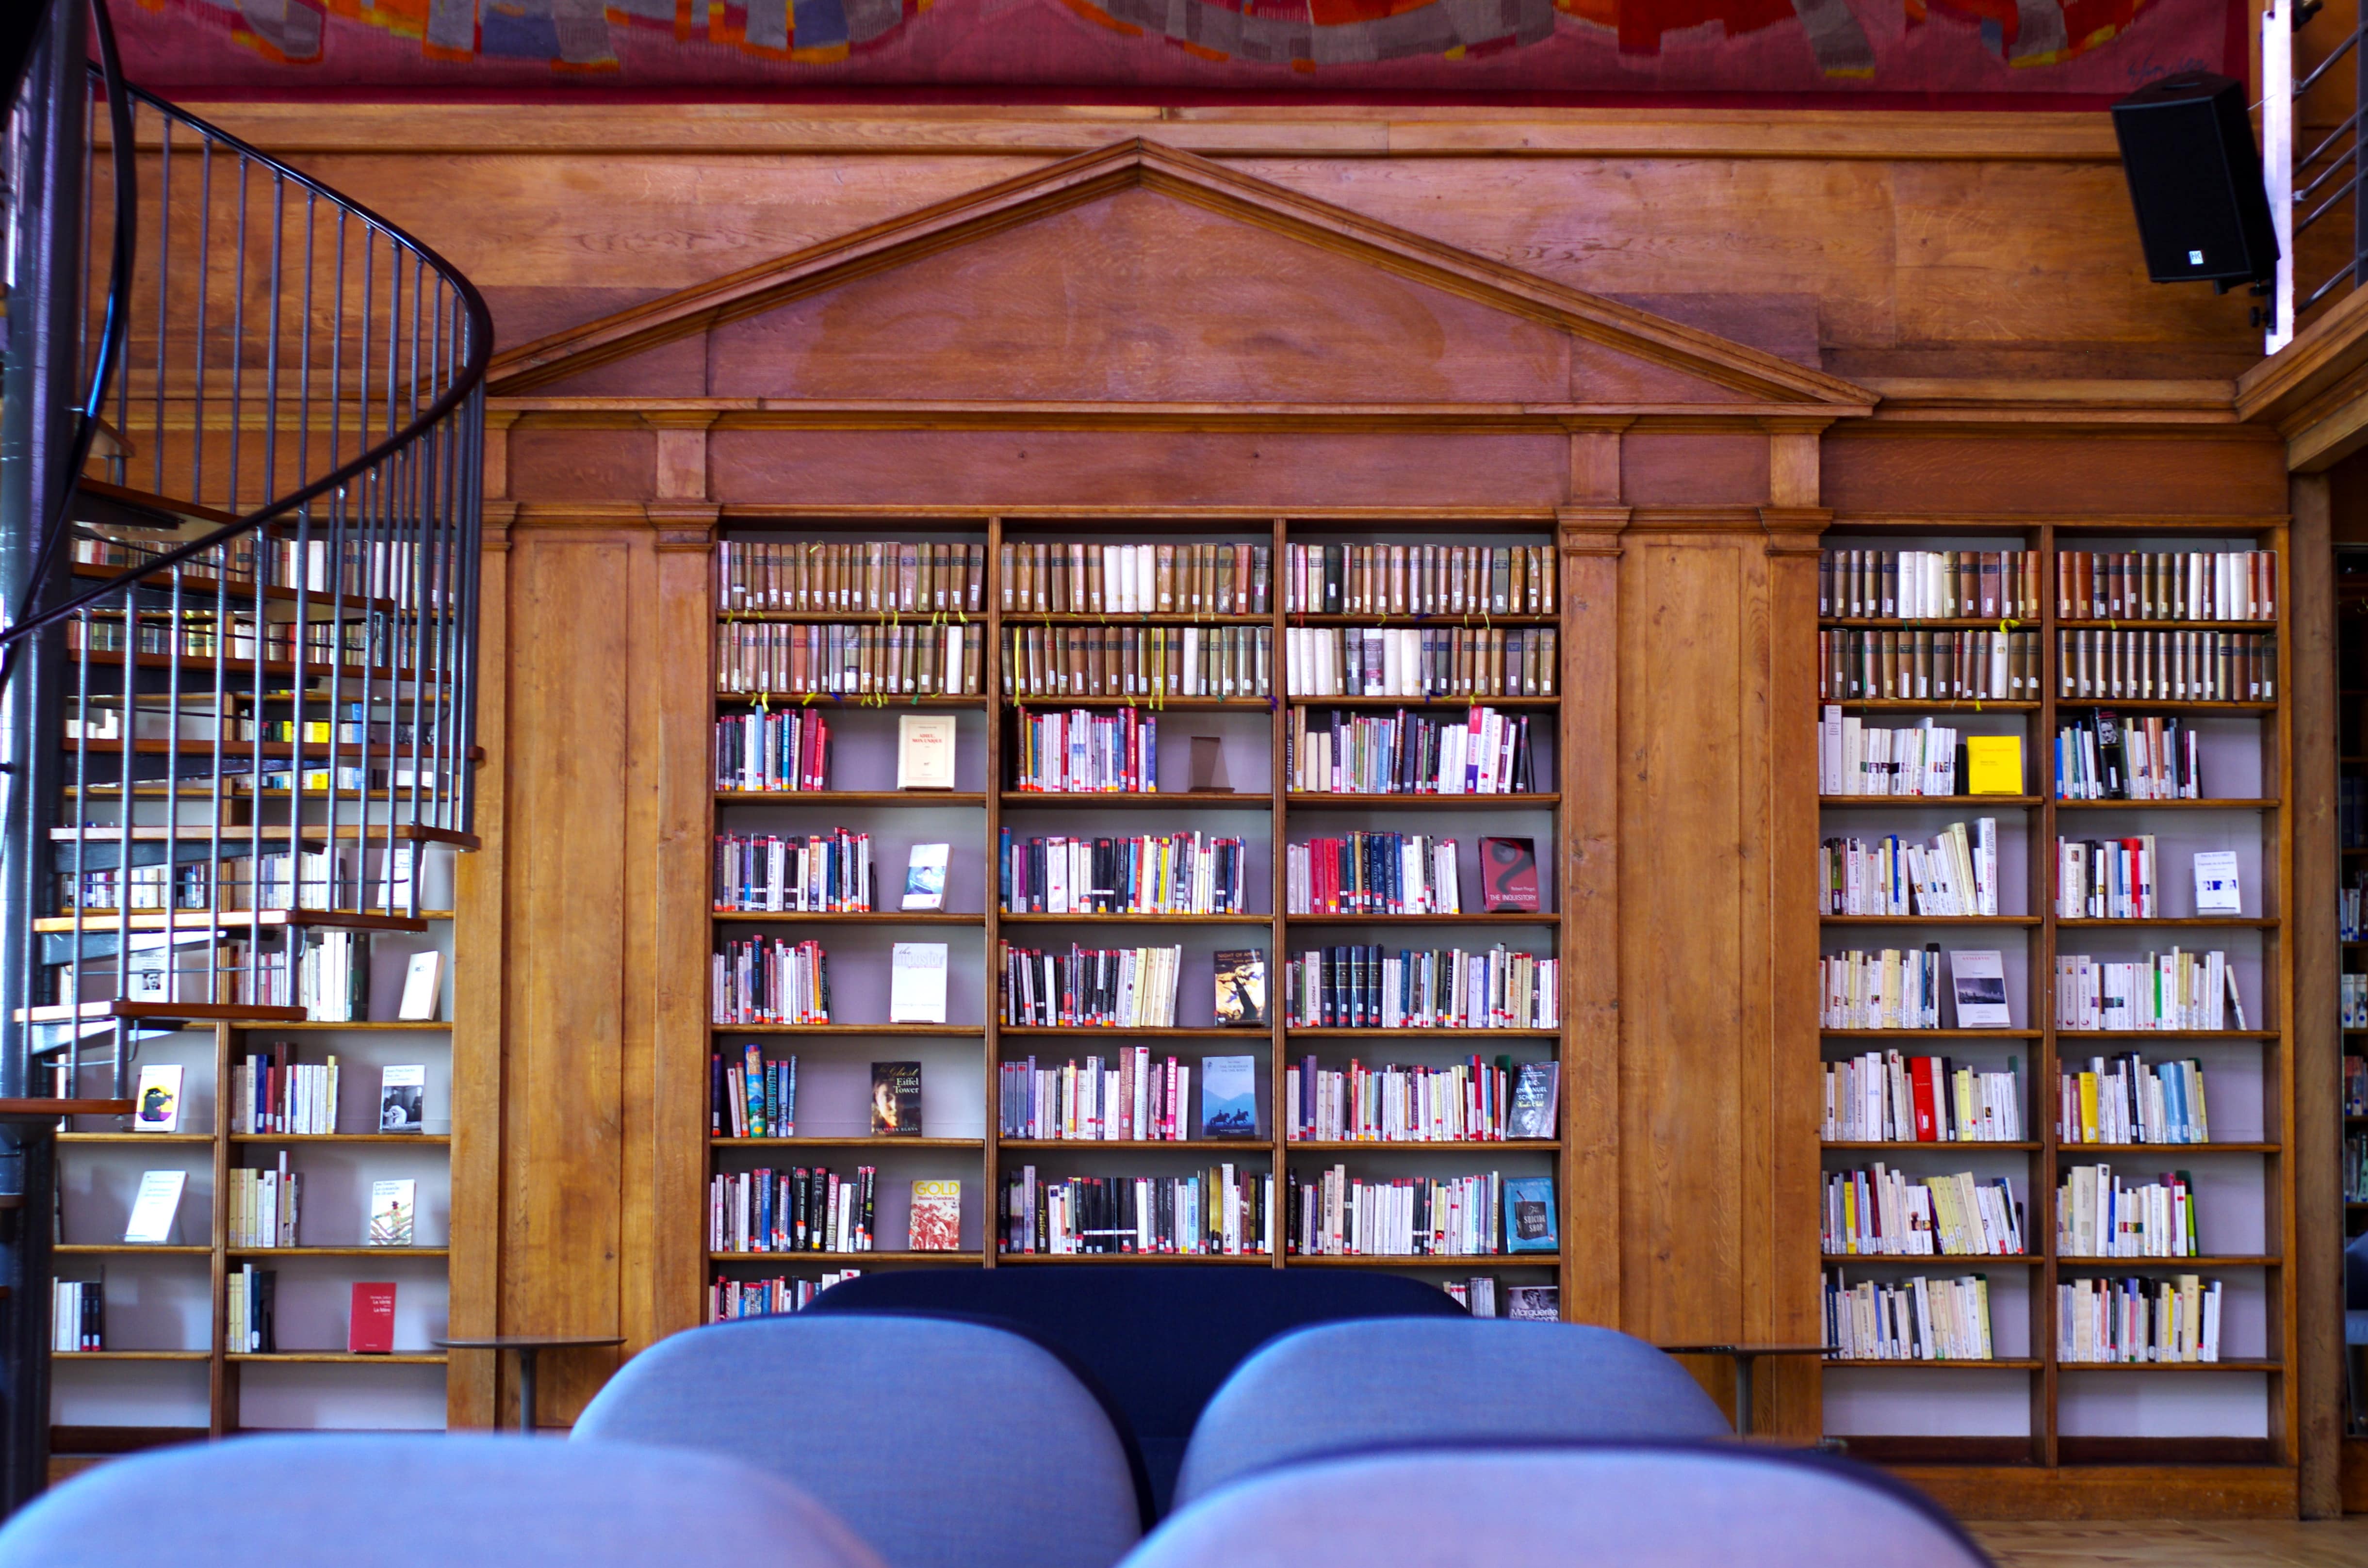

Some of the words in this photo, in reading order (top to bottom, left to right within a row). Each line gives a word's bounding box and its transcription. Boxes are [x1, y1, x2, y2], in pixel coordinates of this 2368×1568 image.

[768, 1066, 777, 1095] WILLIAM
[896, 1077, 919, 1086] Eiffel
[892, 1085, 919, 1094] Tower
[768, 1096, 777, 1116] BOYD
[914, 1181, 960, 1196] GOLD
[1523, 1214, 1546, 1224] SUICIDE
[1529, 1224, 1544, 1233] SHOP
[1511, 1308, 1559, 1317] Marguerite
